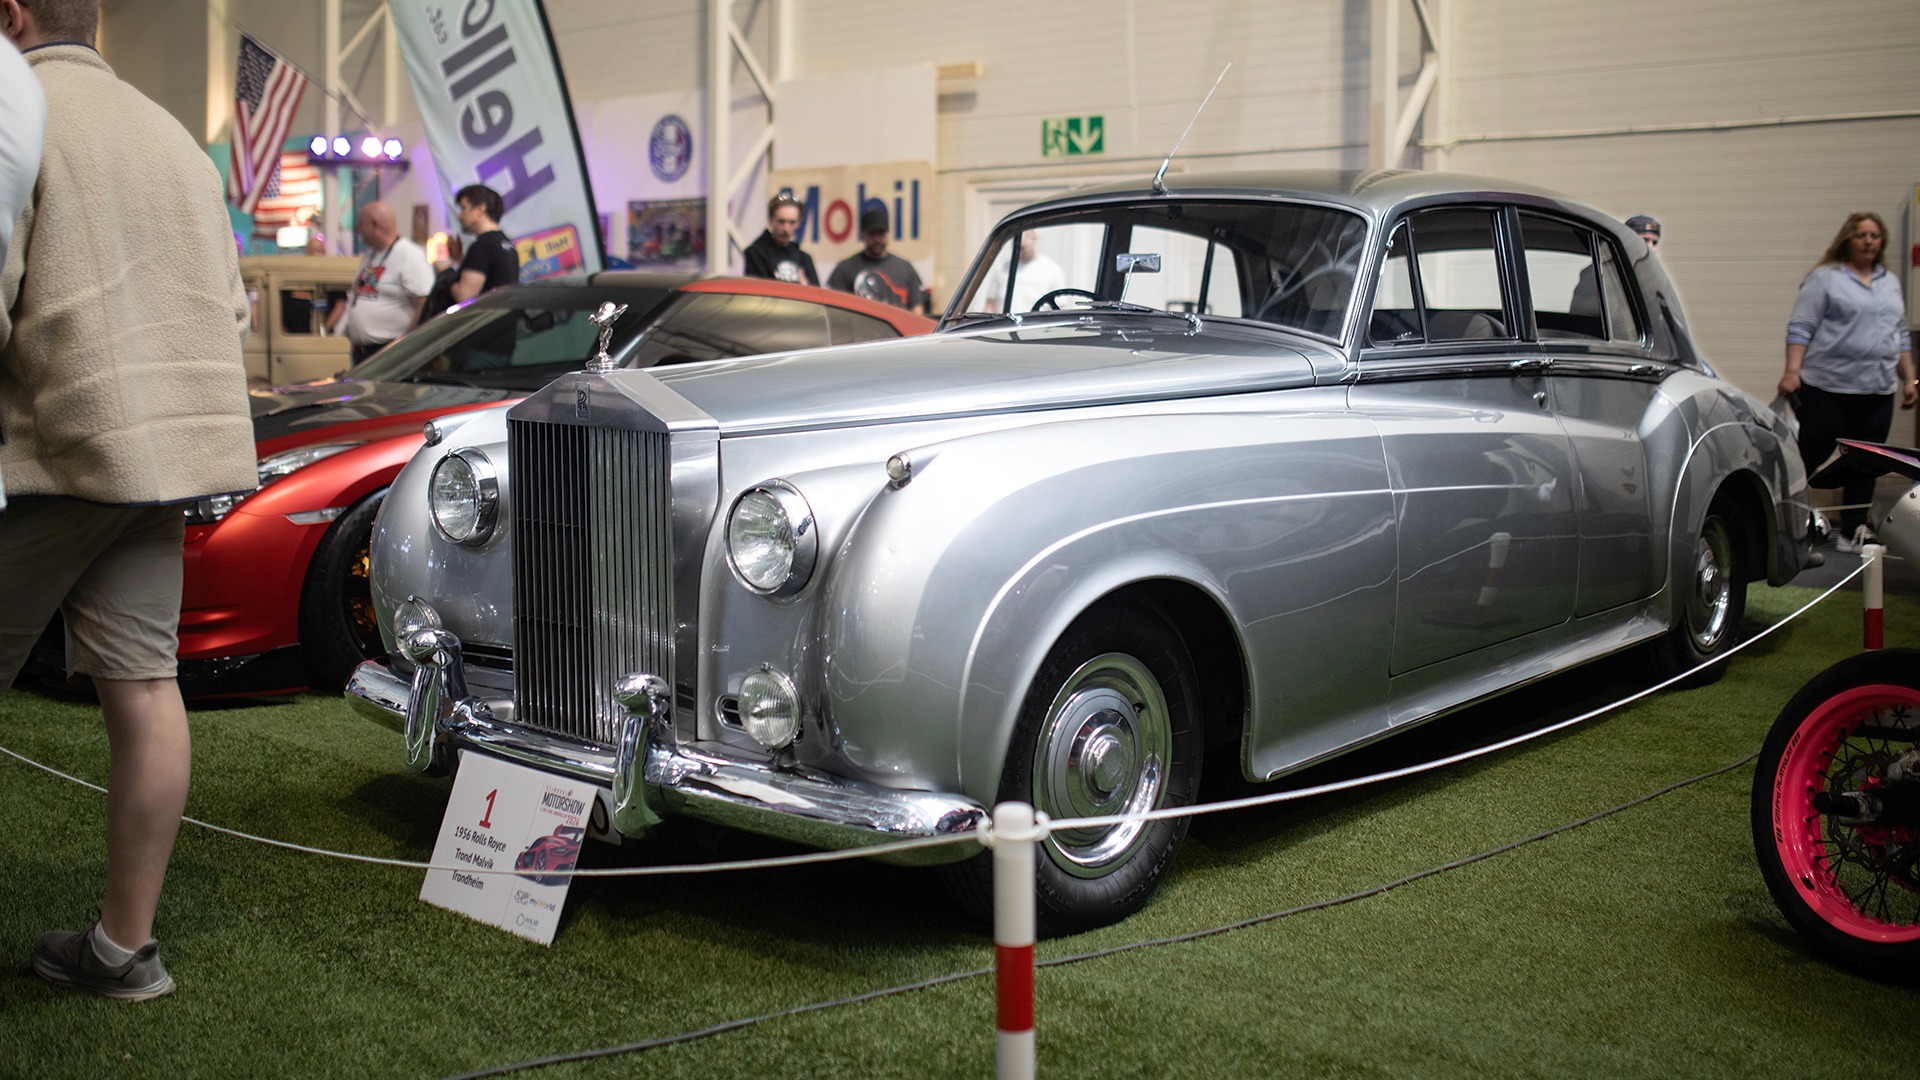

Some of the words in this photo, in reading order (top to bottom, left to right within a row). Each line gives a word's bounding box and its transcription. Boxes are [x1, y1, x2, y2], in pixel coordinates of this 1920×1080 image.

[479, 789, 498, 829] 1
[542, 792, 586, 816] MOTORSHOW
[455, 826, 471, 841] 1956
[471, 832, 487, 847] Rolls
[487, 837, 507, 852] Royce
[455, 848, 472, 863] Trond
[472, 853, 494, 869] Malvik
[452, 870, 484, 890] Trondheim
